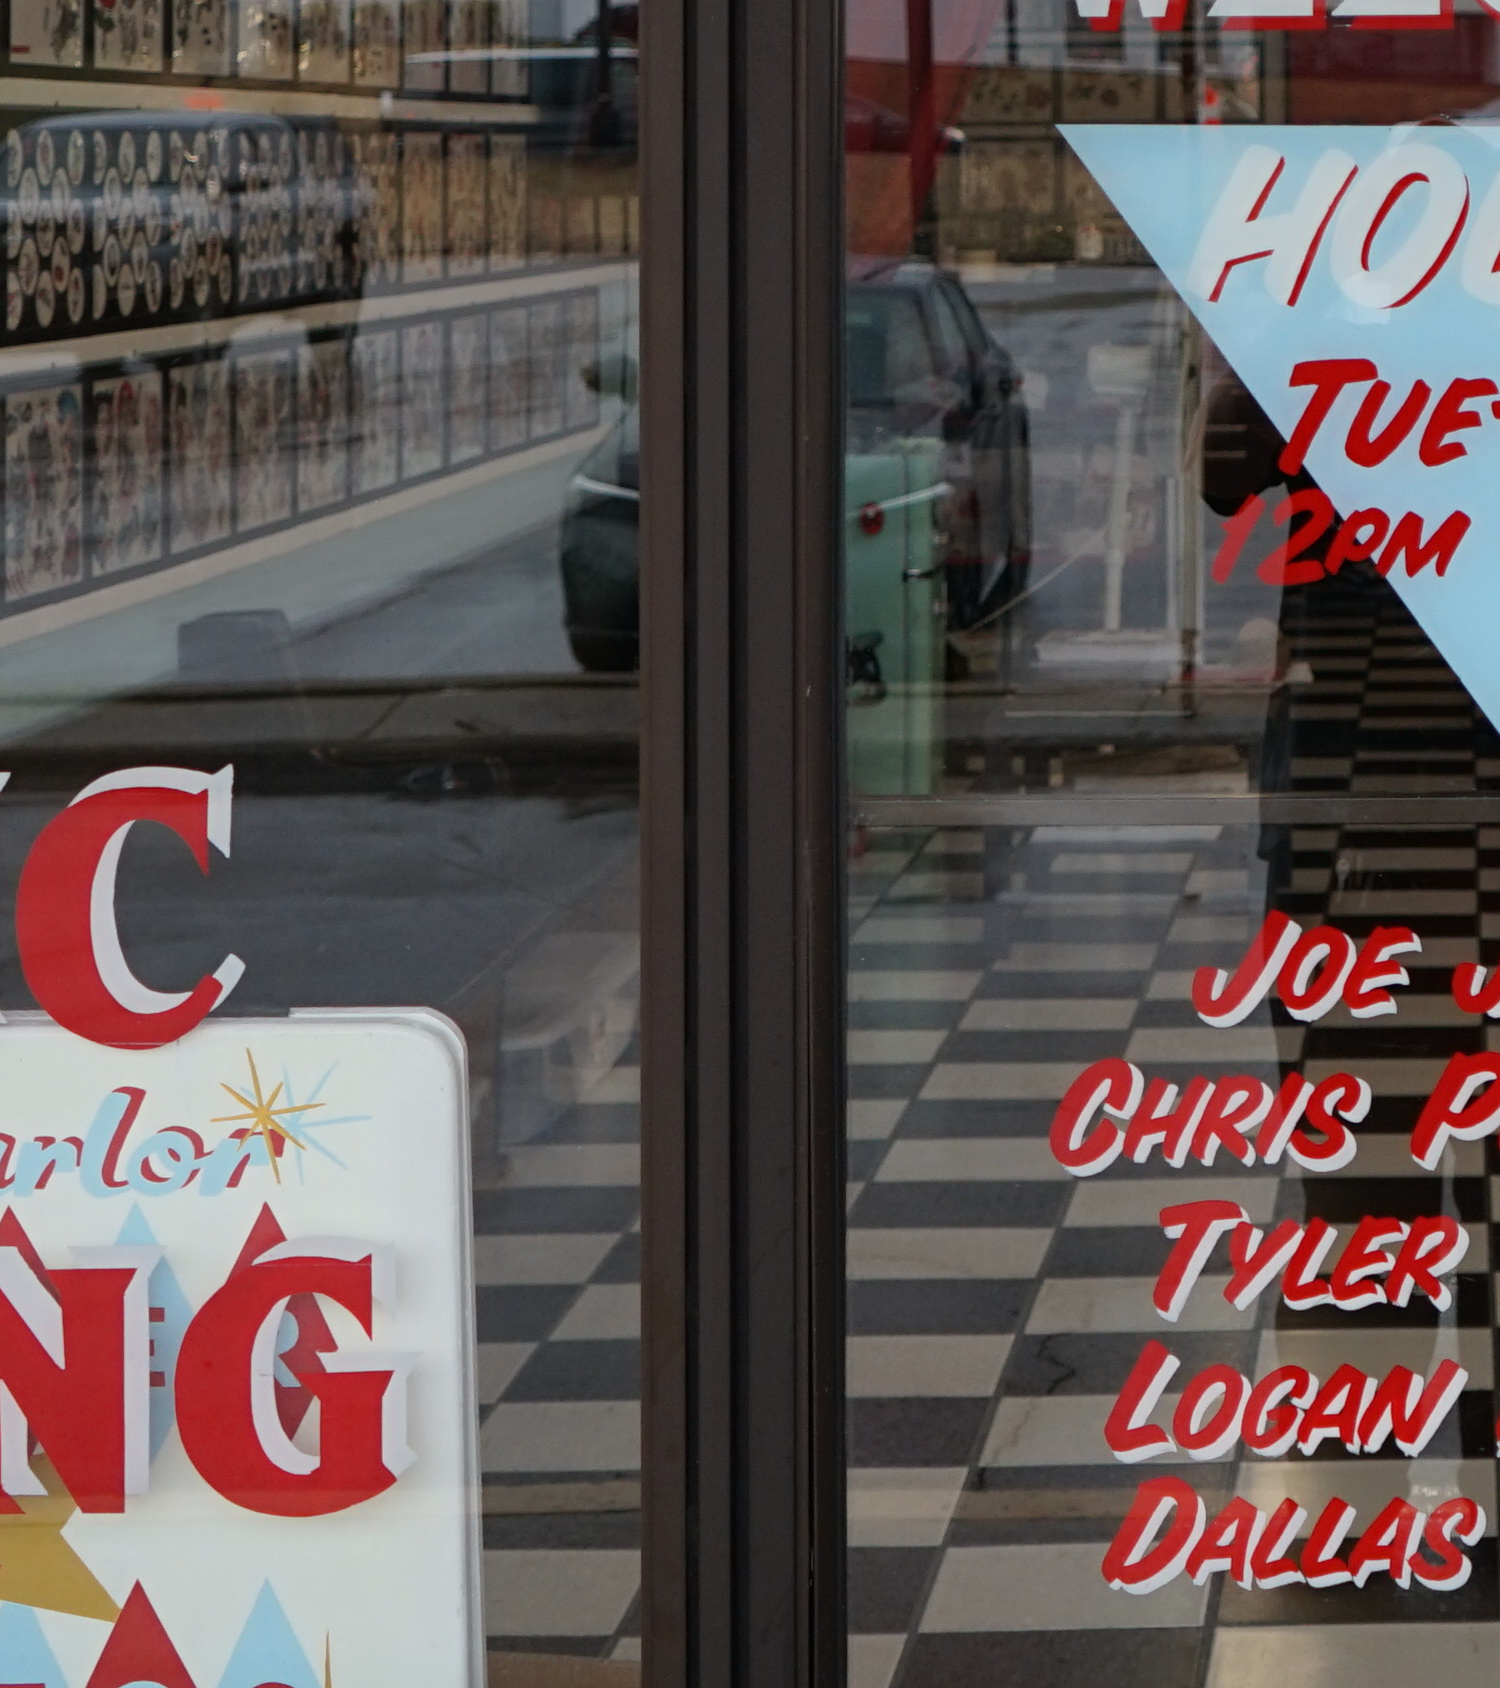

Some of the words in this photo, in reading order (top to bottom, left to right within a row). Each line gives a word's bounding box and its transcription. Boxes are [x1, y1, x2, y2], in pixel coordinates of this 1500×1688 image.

[1210, 495, 1471, 586] 12PM
[1192, 910, 1422, 1028] JOE
[1050, 1058, 1372, 1178] CHRIS
[1152, 1200, 1467, 1323] TYLER
[1104, 1340, 1467, 1465] LOGAN
[1101, 1477, 1486, 1596] DALLAS
